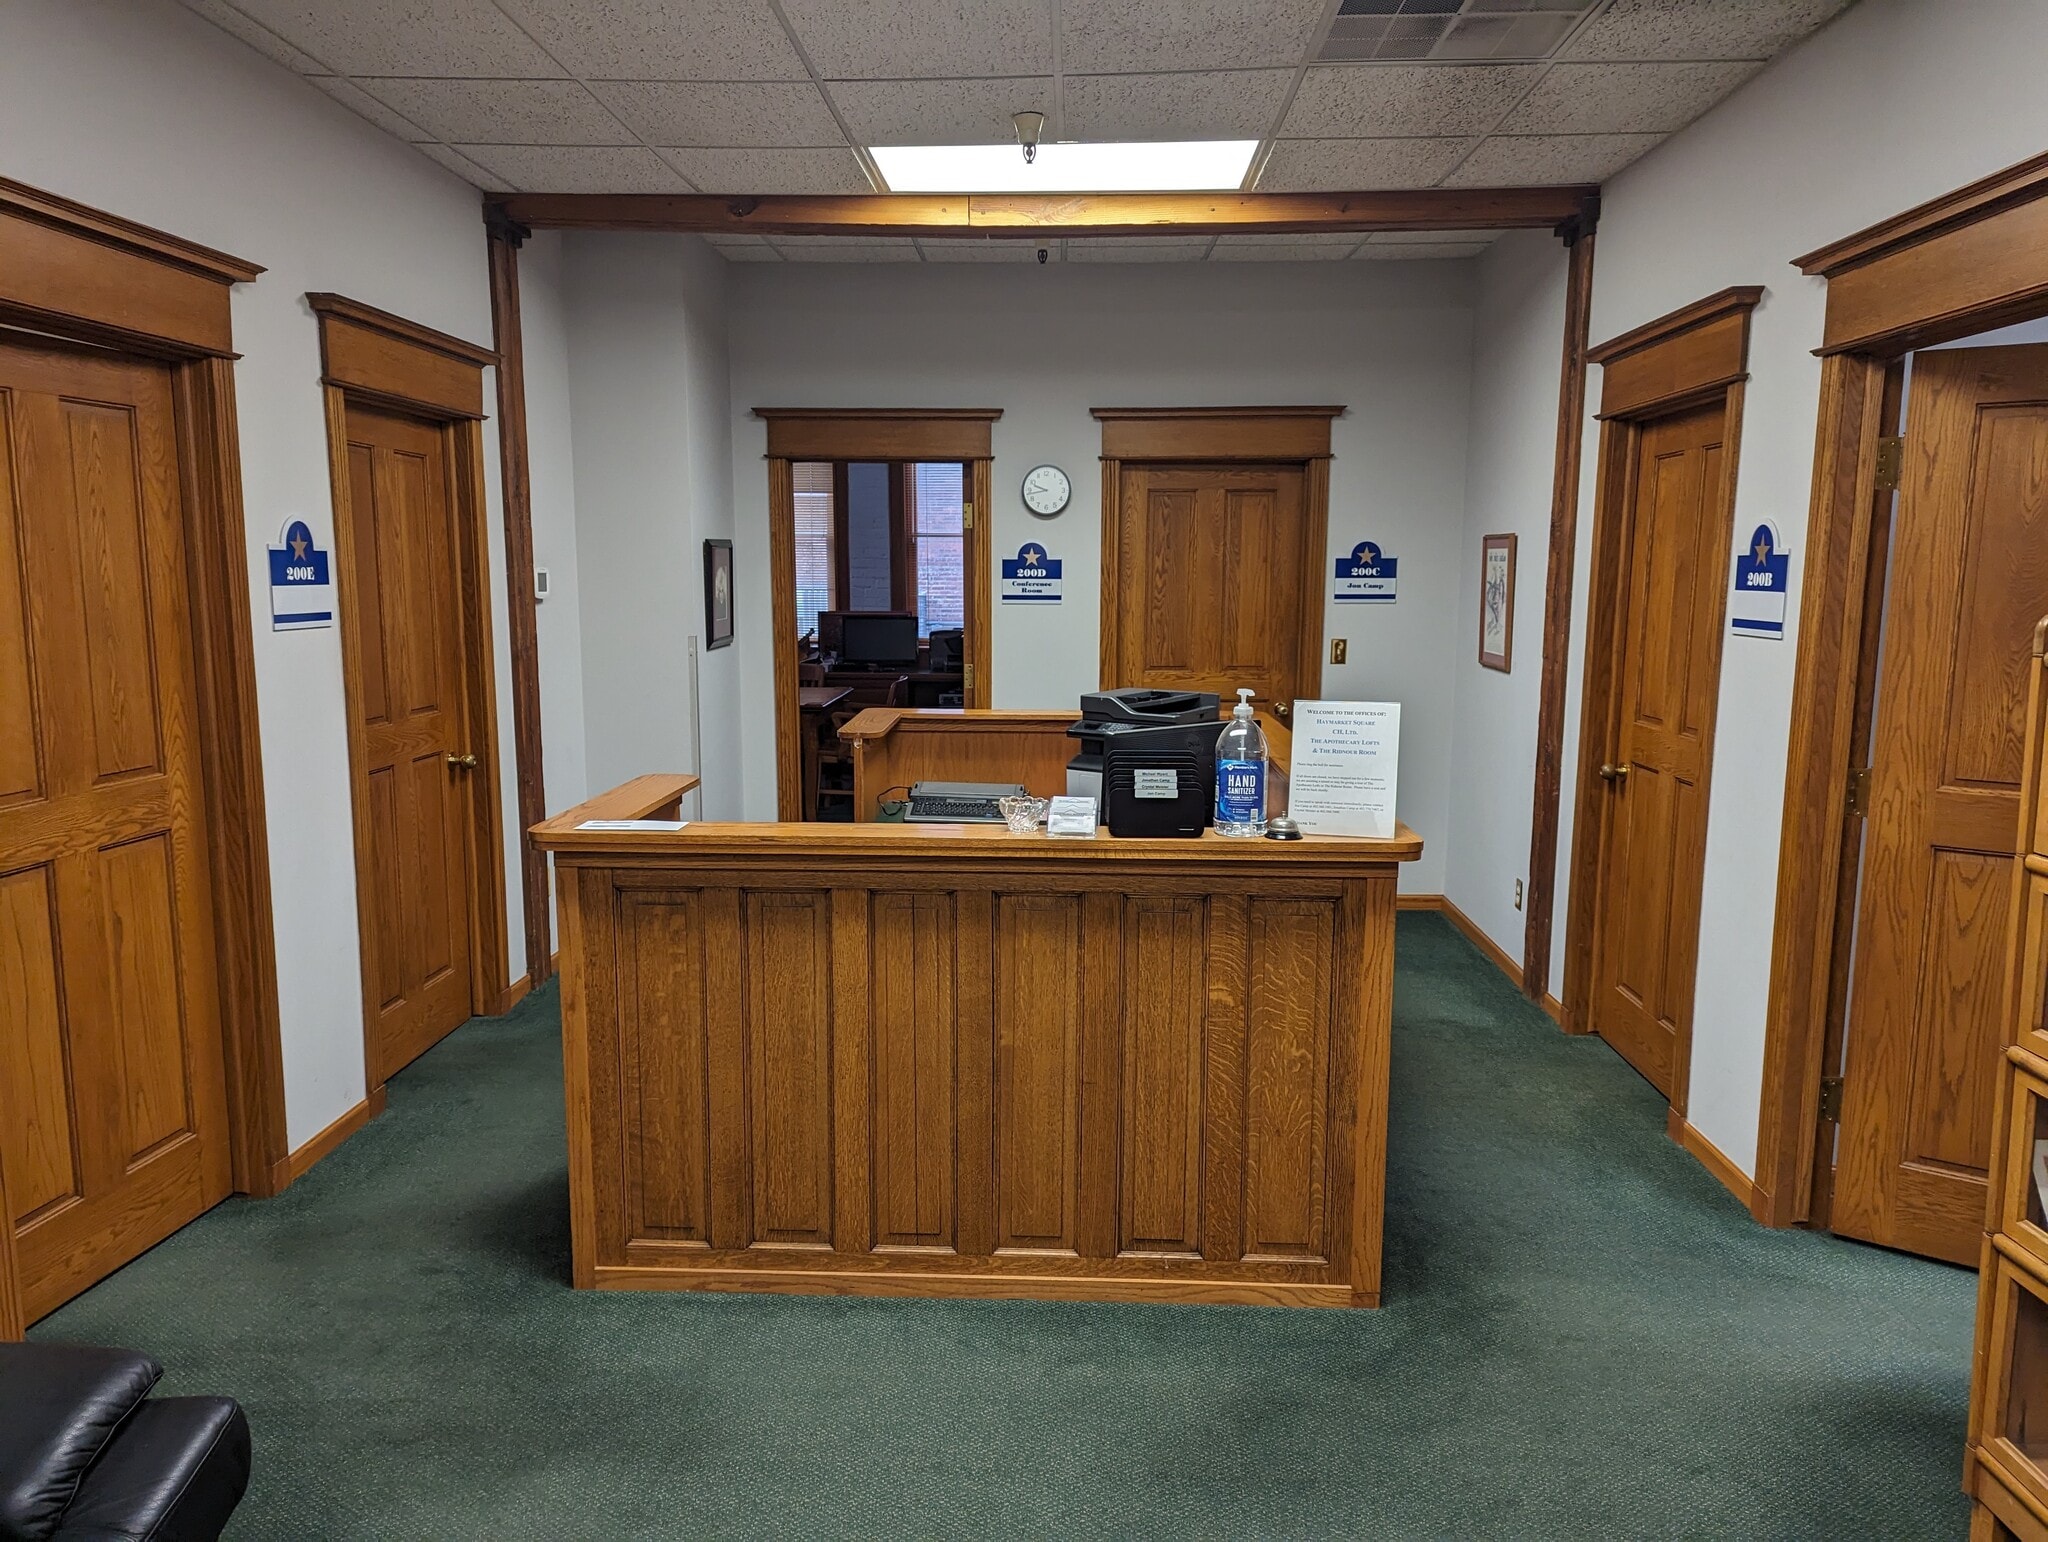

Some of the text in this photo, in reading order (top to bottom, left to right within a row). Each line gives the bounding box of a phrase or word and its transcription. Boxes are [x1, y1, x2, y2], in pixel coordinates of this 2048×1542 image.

[1052, 501, 1058, 509] 5
[286, 566, 315, 581] 200E
[1016, 568, 1047, 578] 200D
[1350, 567, 1381, 576] 200C
[1746, 572, 1773, 587] 200B
[1228, 774, 1256, 787] HAND
[1227, 787, 1255, 795] SANITIZER
